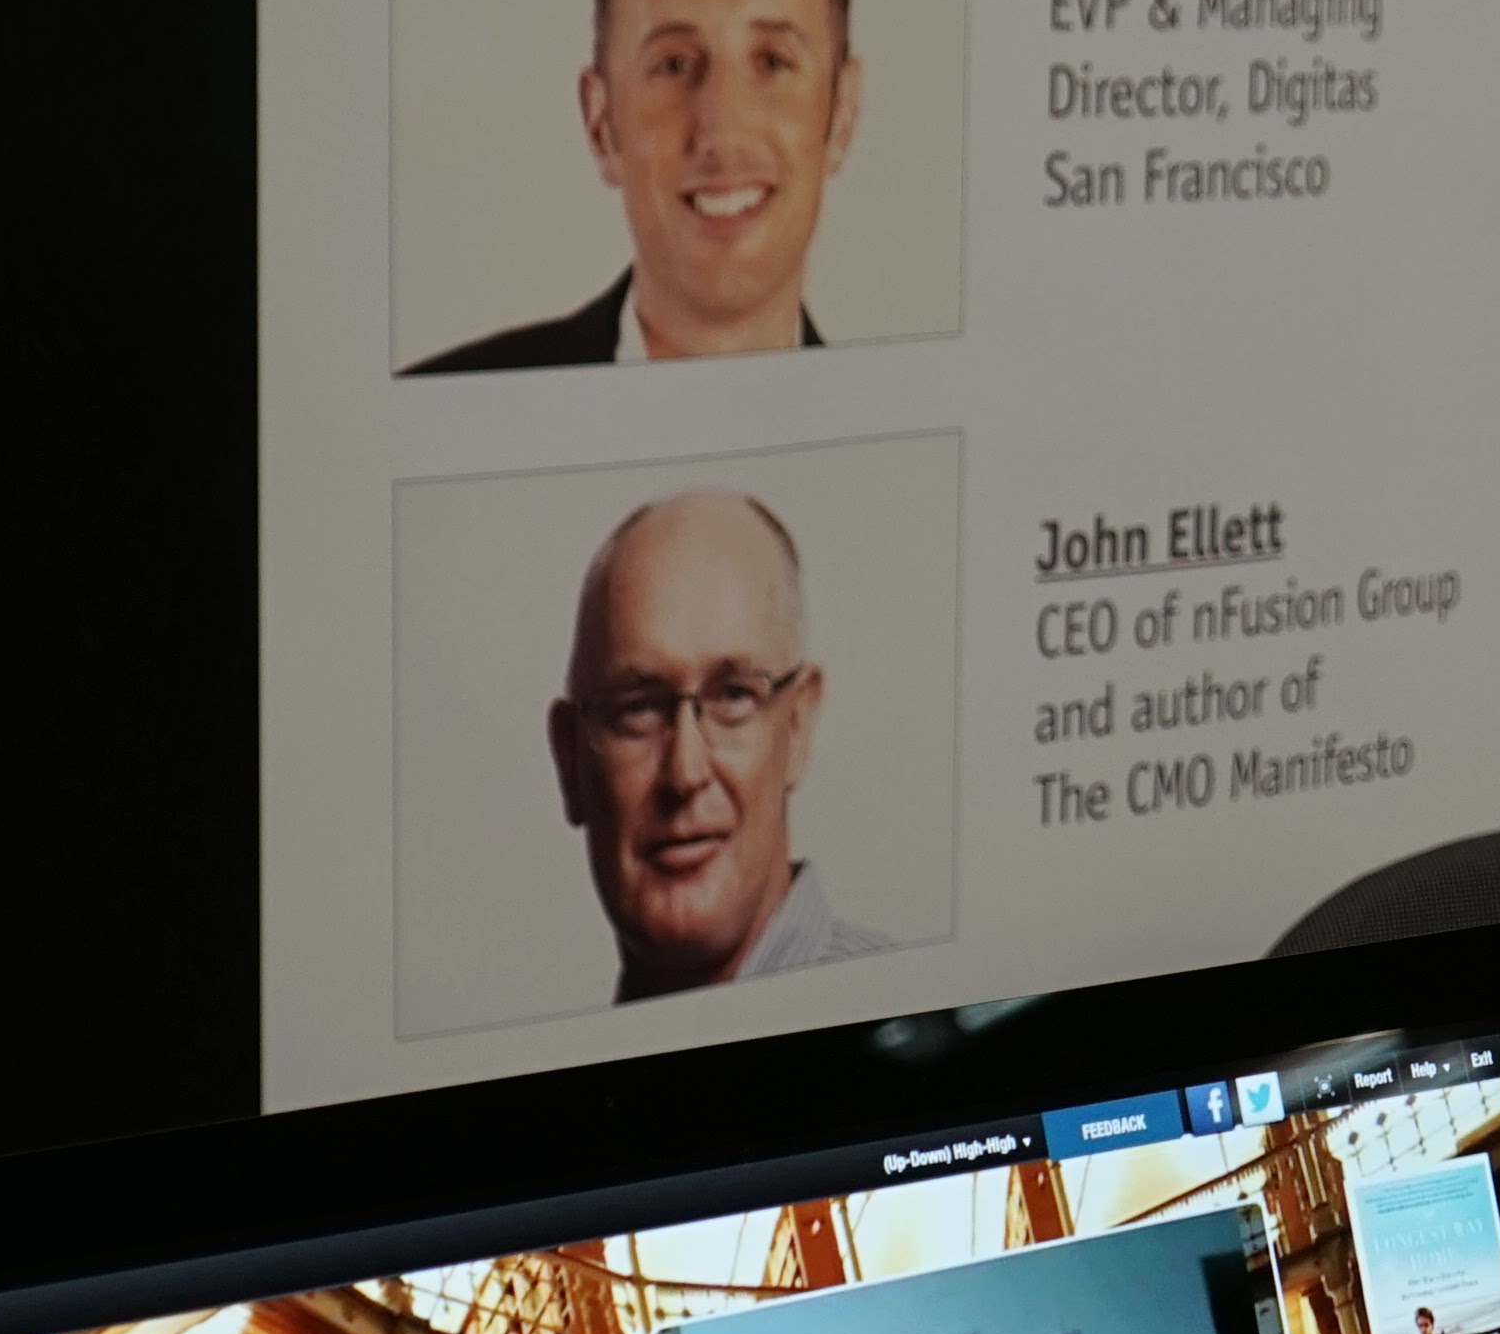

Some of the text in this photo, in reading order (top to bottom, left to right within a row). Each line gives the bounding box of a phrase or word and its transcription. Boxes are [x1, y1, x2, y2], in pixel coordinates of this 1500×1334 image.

[1046, 57, 1379, 131] Director, Digitas
[1043, 142, 1332, 209] San Francisco
[1034, 503, 1285, 577] John Ellett
[1034, 566, 1462, 661] CEO of nFusion Group
[1032, 656, 1323, 746] and author of
[1031, 731, 1416, 827] The CMO Manifesto
[1354, 1068, 1394, 1089] Report
[1410, 1061, 1437, 1079] Help
[1471, 1050, 1494, 1068] Exit
[1081, 1114, 1147, 1140] FEEDBACK
